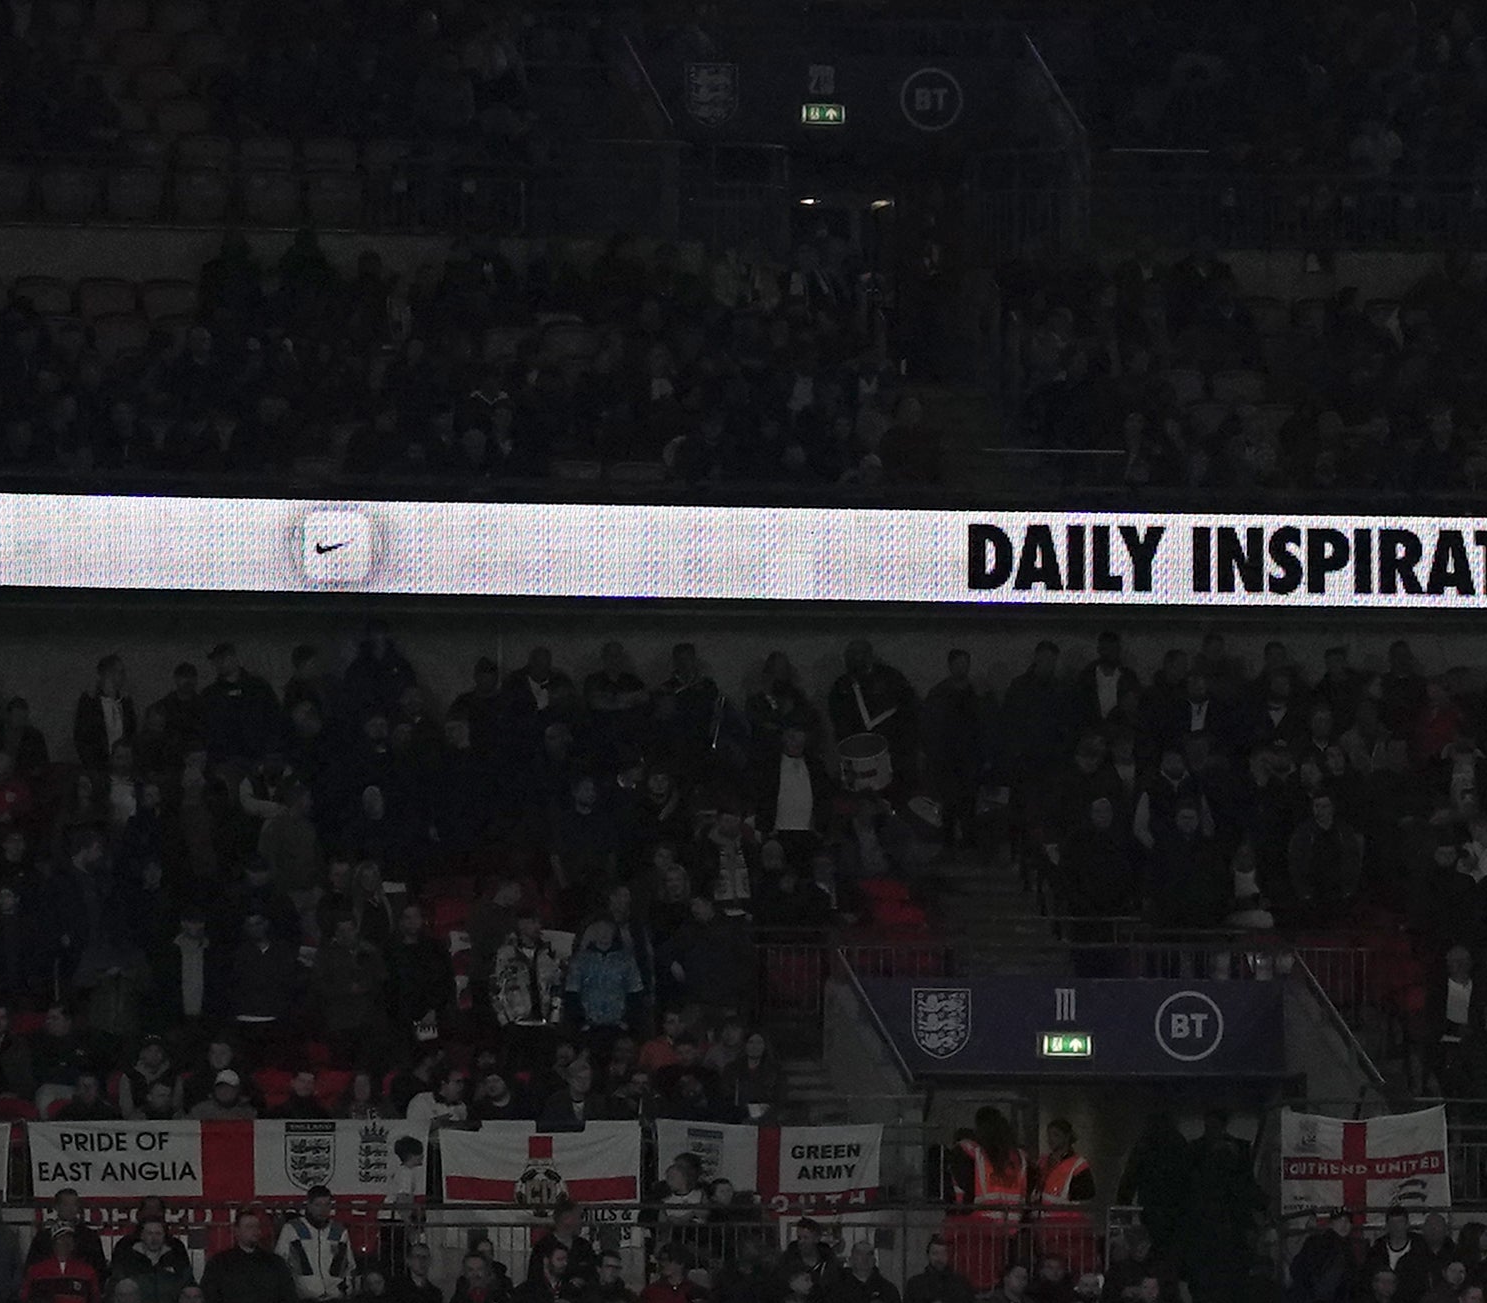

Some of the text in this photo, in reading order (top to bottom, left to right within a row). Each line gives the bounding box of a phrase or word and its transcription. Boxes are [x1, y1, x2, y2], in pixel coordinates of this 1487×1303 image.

[914, 88, 948, 111] BT
[968, 523, 1164, 593] DAILY
[1169, 1013, 1208, 1038] BT
[59, 1131, 169, 1152] PRIDE OF
[791, 1144, 861, 1160] GREEN
[38, 1161, 197, 1182] EAST ANGLIA
[797, 1164, 856, 1180] ARMY
[1286, 1156, 1440, 1176] OUTHEND UNITED
